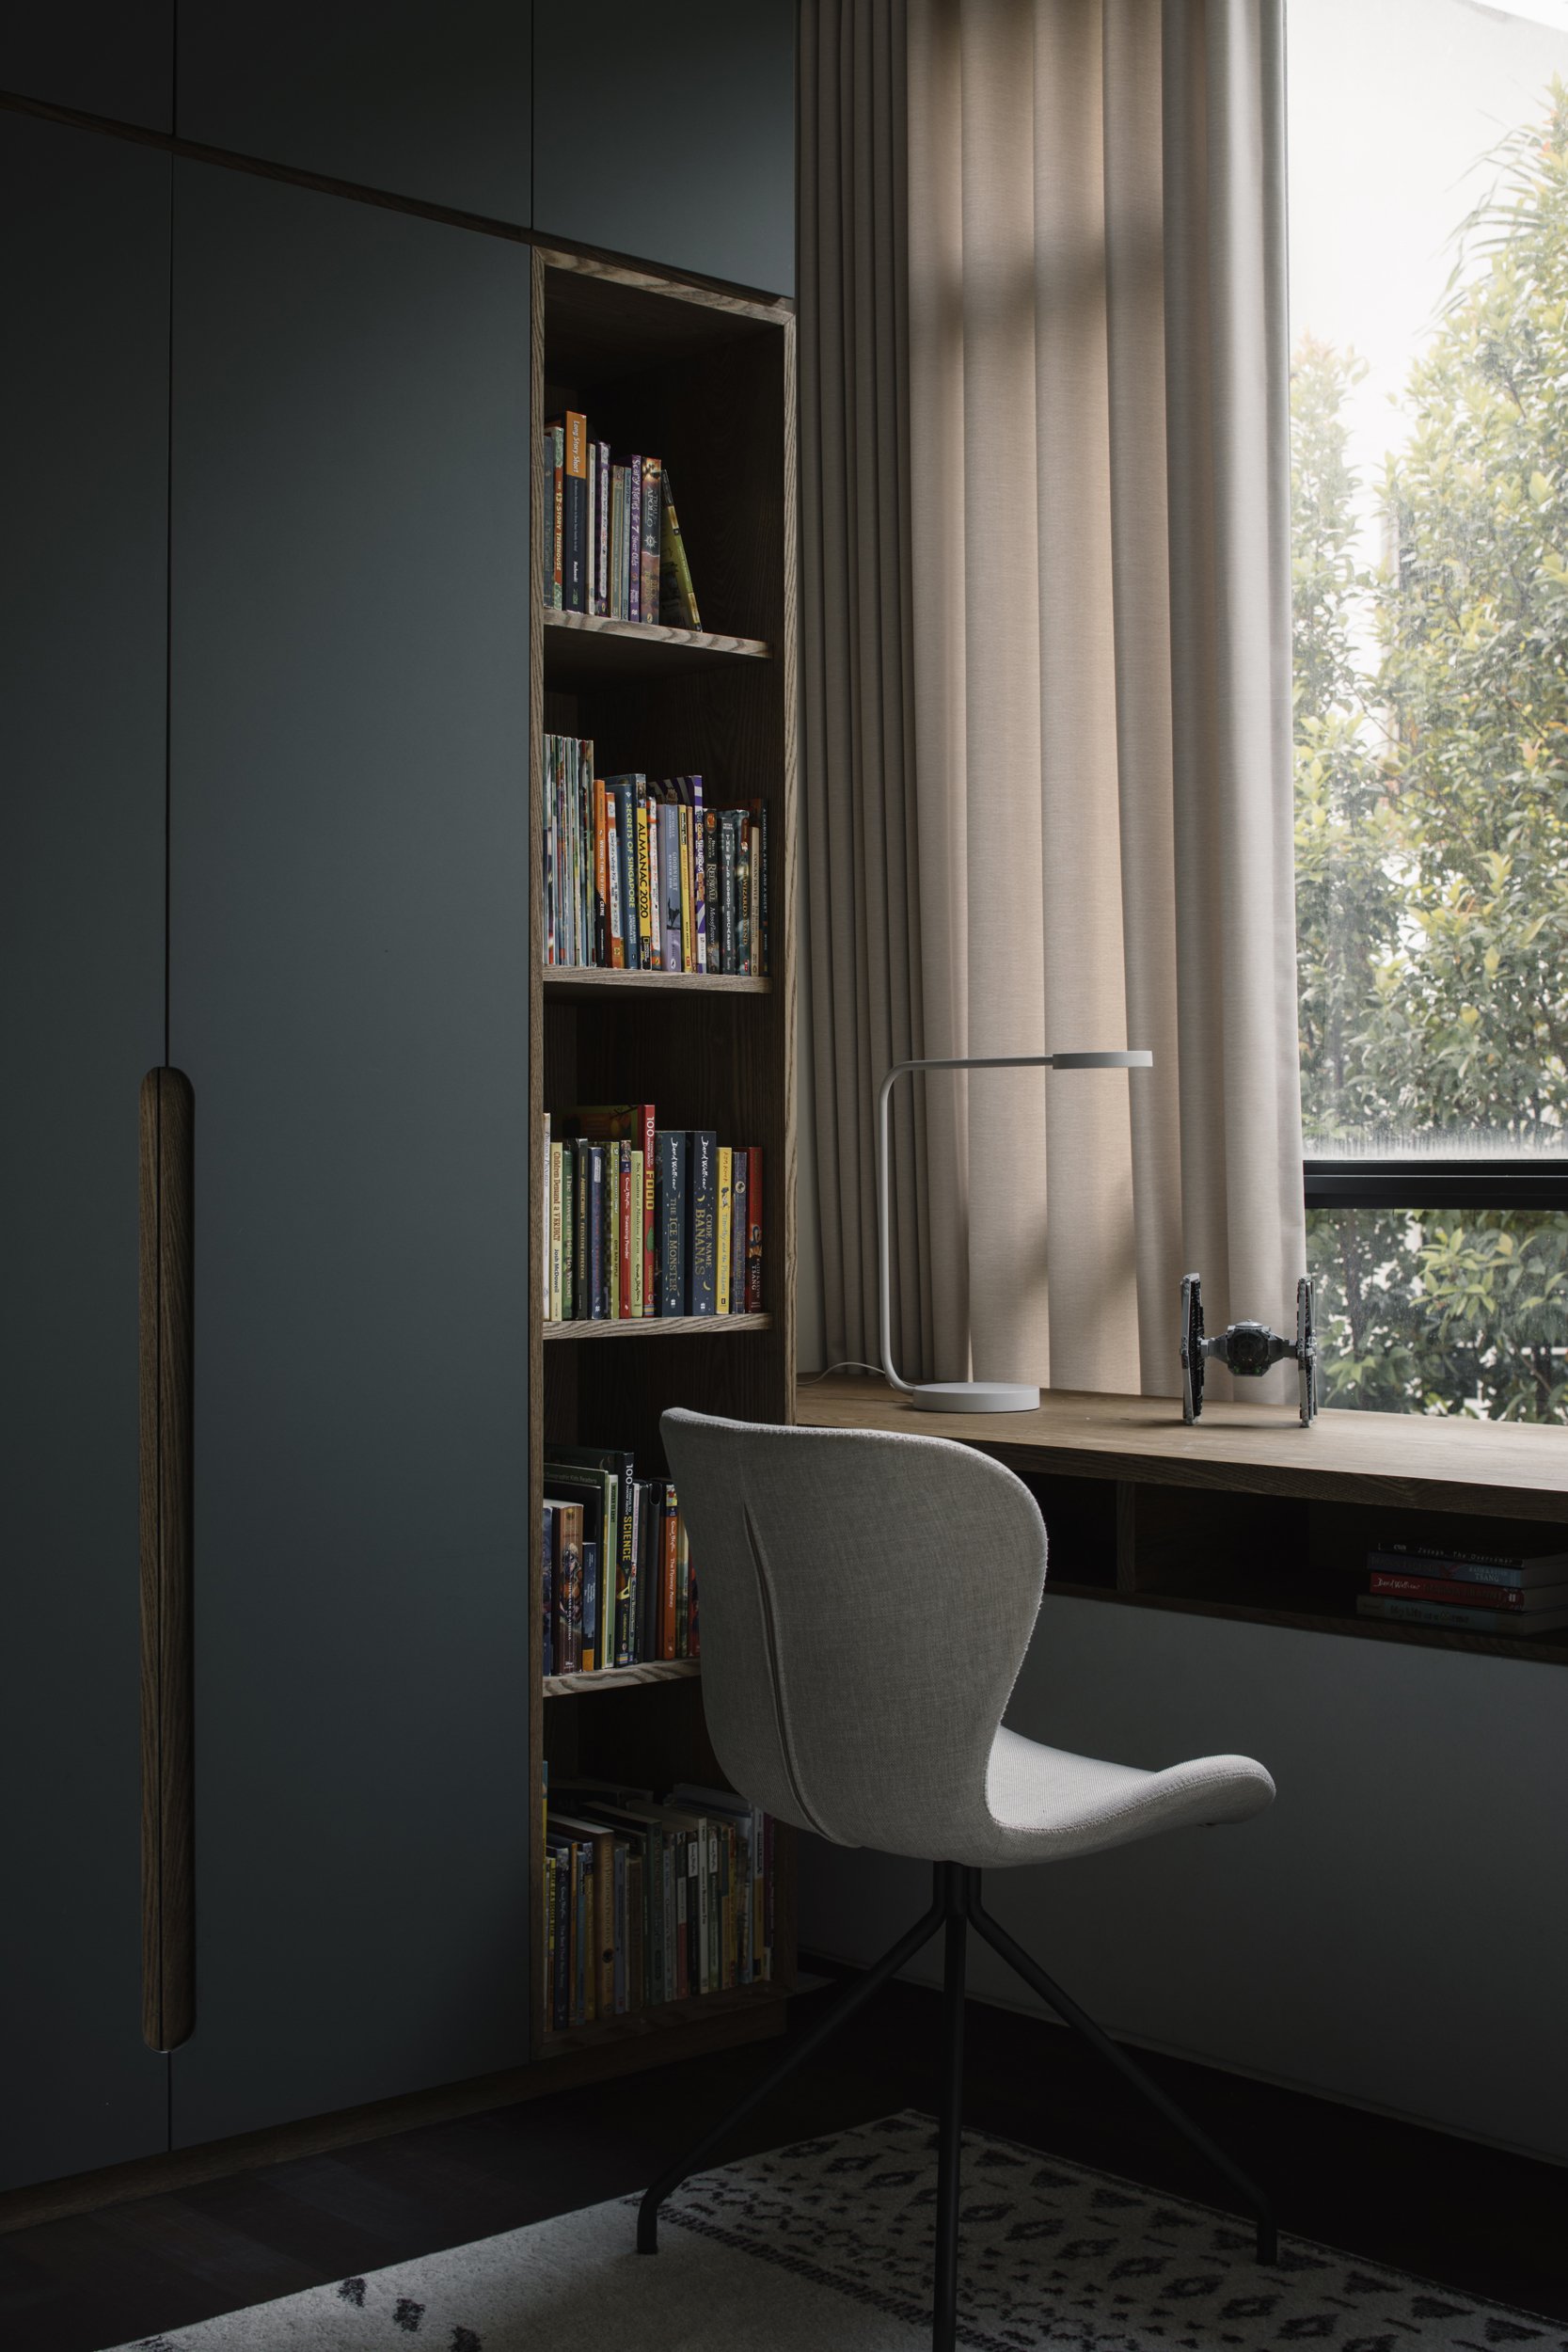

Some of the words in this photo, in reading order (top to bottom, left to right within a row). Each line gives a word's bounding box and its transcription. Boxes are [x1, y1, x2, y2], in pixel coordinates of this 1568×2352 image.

[632, 458, 641, 485] Scary
[631, 486, 641, 511] Stories
[631, 525, 640, 534] 7
[630, 552, 639, 567] Olds
[627, 841, 634, 855] OF
[638, 822, 647, 887] ALMANAC
[599, 875, 605, 883] TO
[627, 856, 636, 908] SINGAPORE
[706, 863, 718, 902] REDWALL
[640, 889, 649, 918] 2020
[708, 906, 717, 945] Mossflower
[645, 1116, 655, 1137] 100
[671, 1136, 679, 1161] David
[701, 1136, 709, 1160] David
[701, 1160, 709, 1191] Walliams
[645, 1170, 655, 1211] FOOD
[669, 1217, 678, 1236] ICE
[721, 1214, 729, 1241] Timothy
[695, 1208, 706, 1276] BANANAS
[669, 1240, 678, 1293] MONSTER
[625, 1463, 634, 1486] 100
[623, 1516, 633, 1562] SCIENCE
[1453, 1550, 1466, 1559] The
[1470, 1553, 1513, 1564] Overcomer
[1474, 1572, 1499, 1582] TSANG
